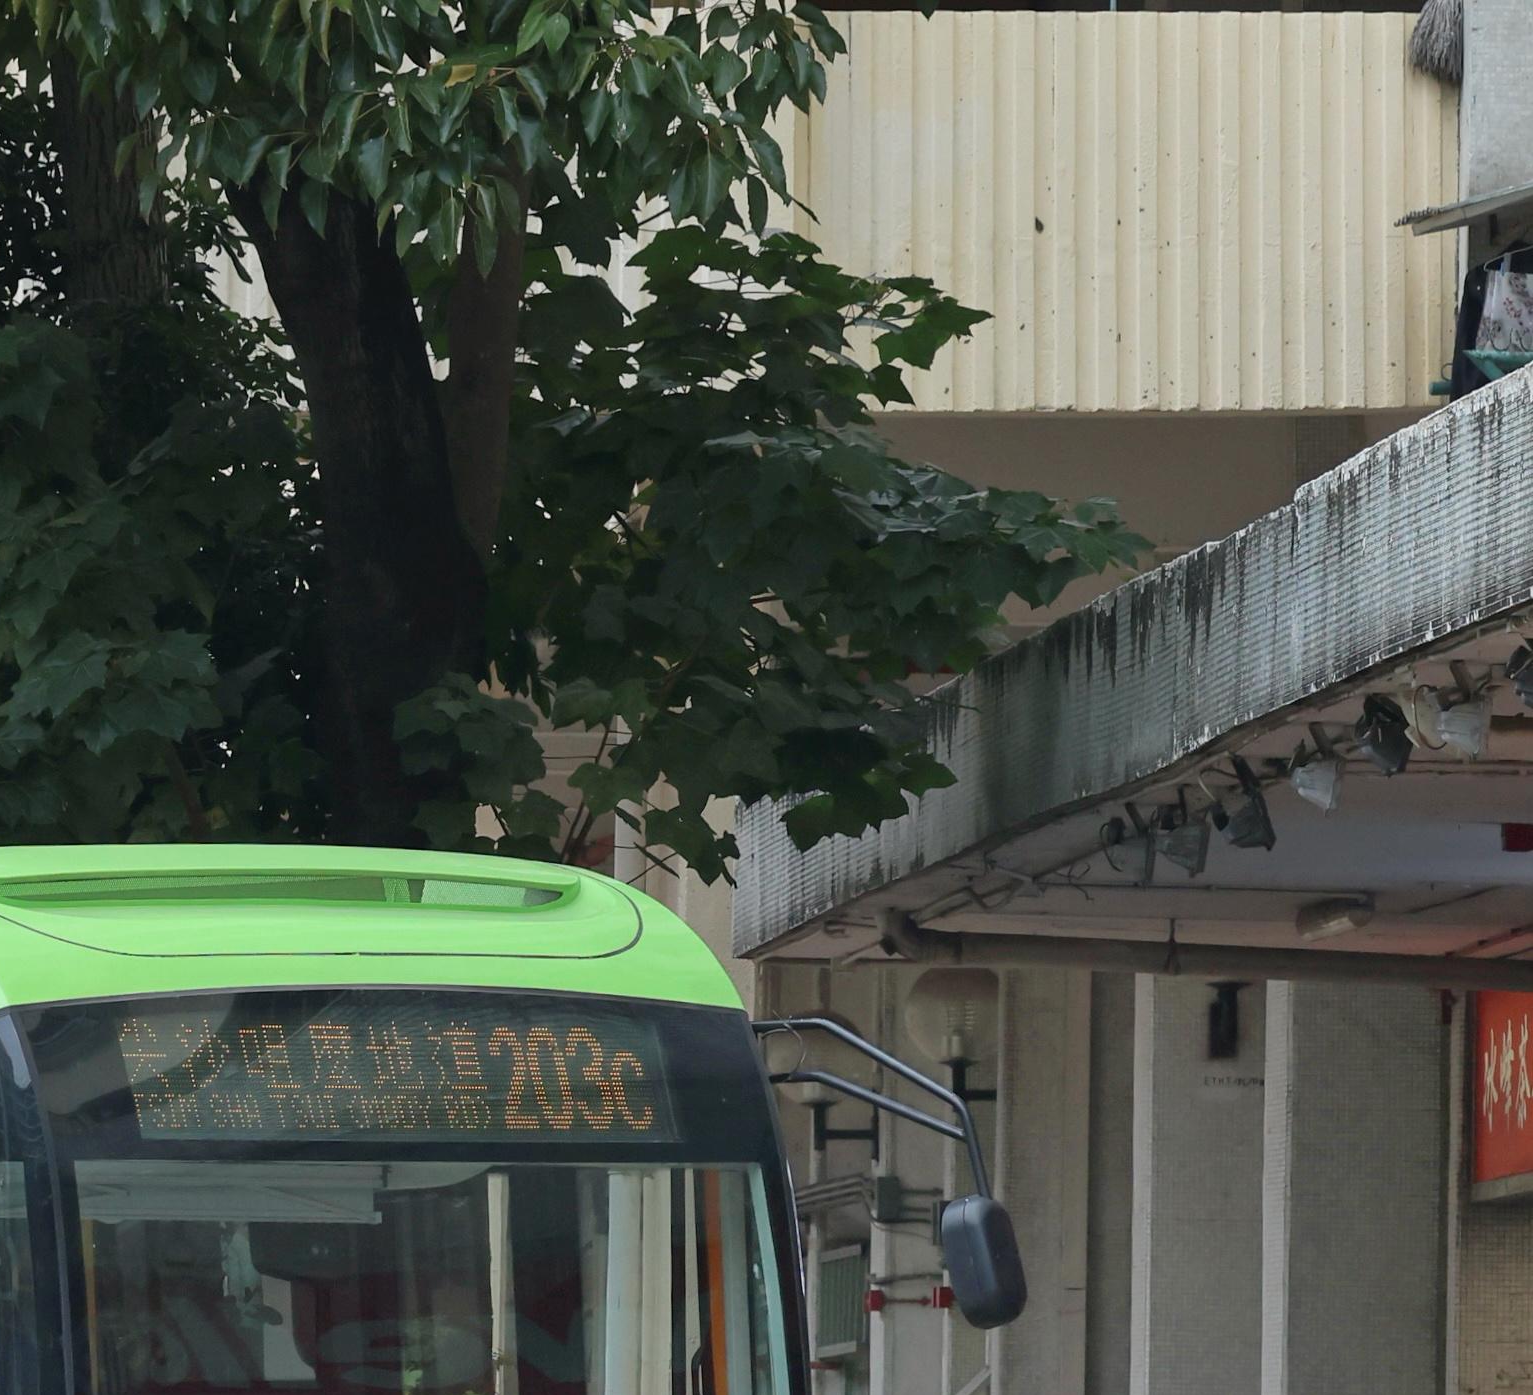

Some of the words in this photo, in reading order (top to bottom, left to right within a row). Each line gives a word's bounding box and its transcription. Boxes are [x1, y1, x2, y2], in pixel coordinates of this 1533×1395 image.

[133, 1093, 201, 1128] TSIM
[210, 1094, 262, 1128] SHA
[270, 1095, 340, 1128] TSUI
[488, 1026, 654, 1131] 203C
